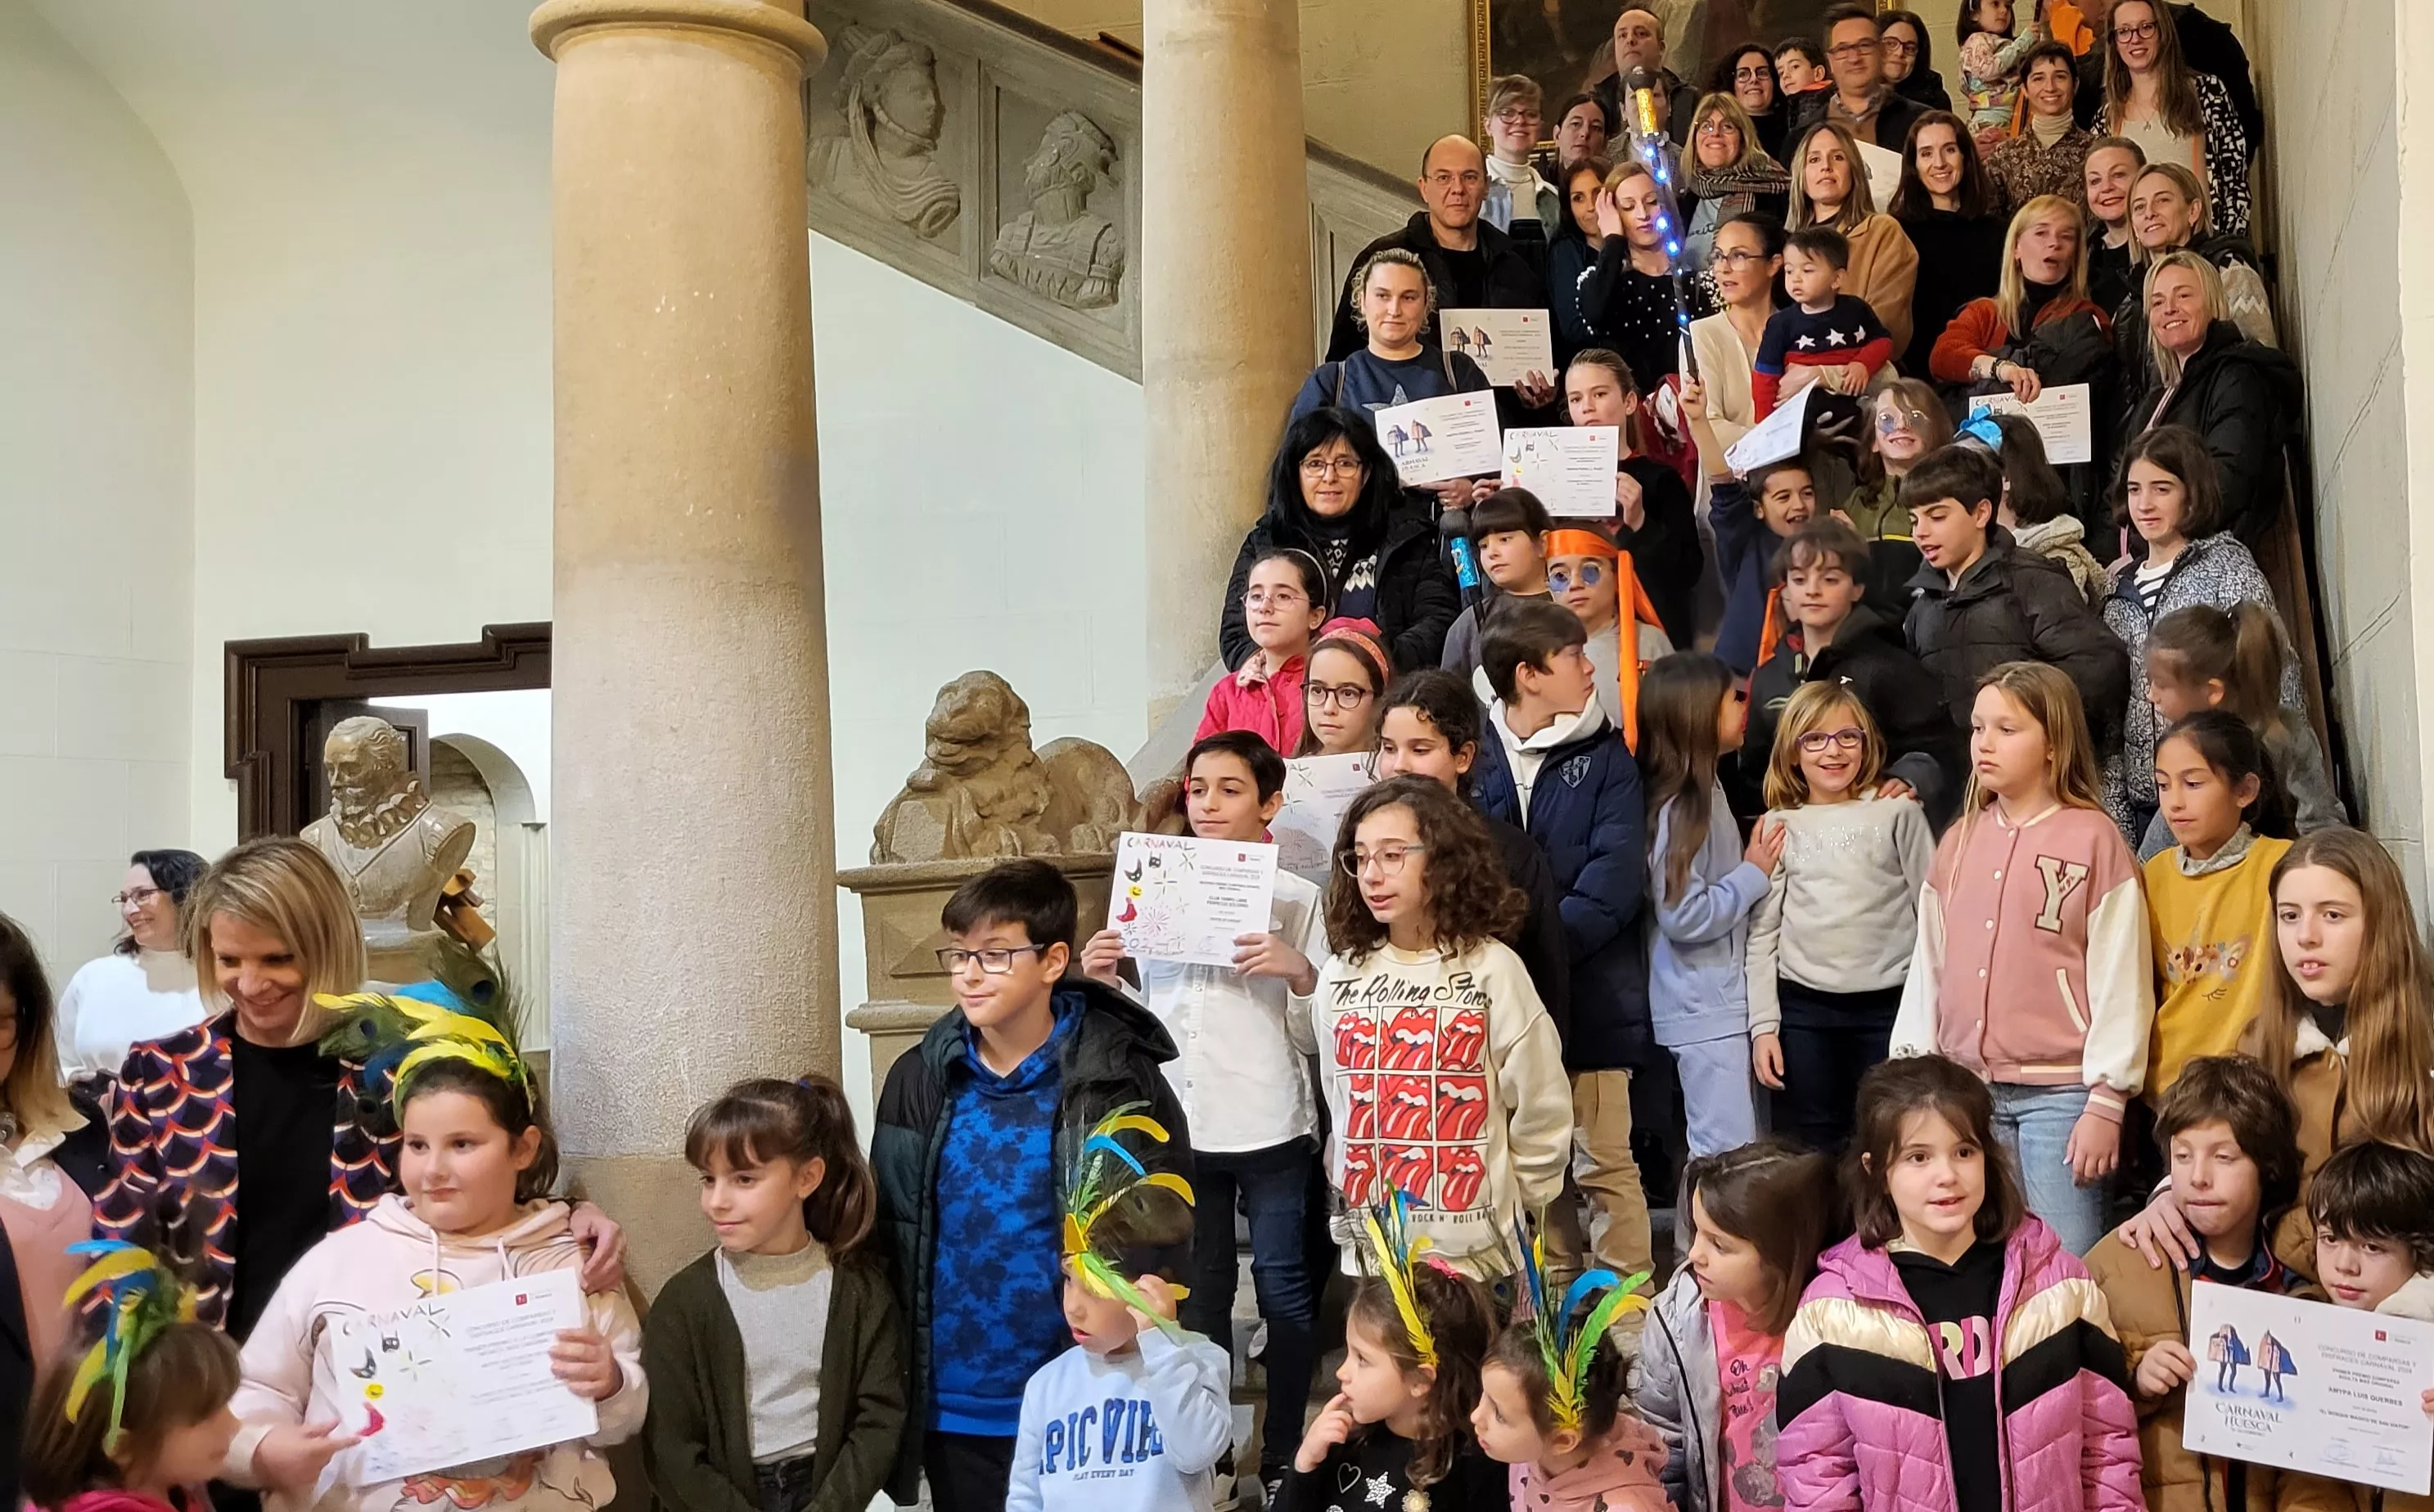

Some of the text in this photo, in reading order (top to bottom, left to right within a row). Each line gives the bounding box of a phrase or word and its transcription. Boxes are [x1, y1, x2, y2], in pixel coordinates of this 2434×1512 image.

[1127, 837, 1196, 851] CARNAVAL
[2035, 853, 2090, 934] Y
[1330, 978, 1363, 1006] The
[1361, 973, 1431, 1013] Rolling
[1412, 1213, 1434, 1223] ROCK
[1454, 1213, 1473, 1224] ROLL
[2353, 1391, 2369, 1401] LUIS
[2215, 1401, 2283, 1424] CARNAVAL
[2224, 1415, 2274, 1433] HUESCA
[1039, 1406, 1098, 1475] PIC
[1118, 1469, 1134, 1478] DAY
